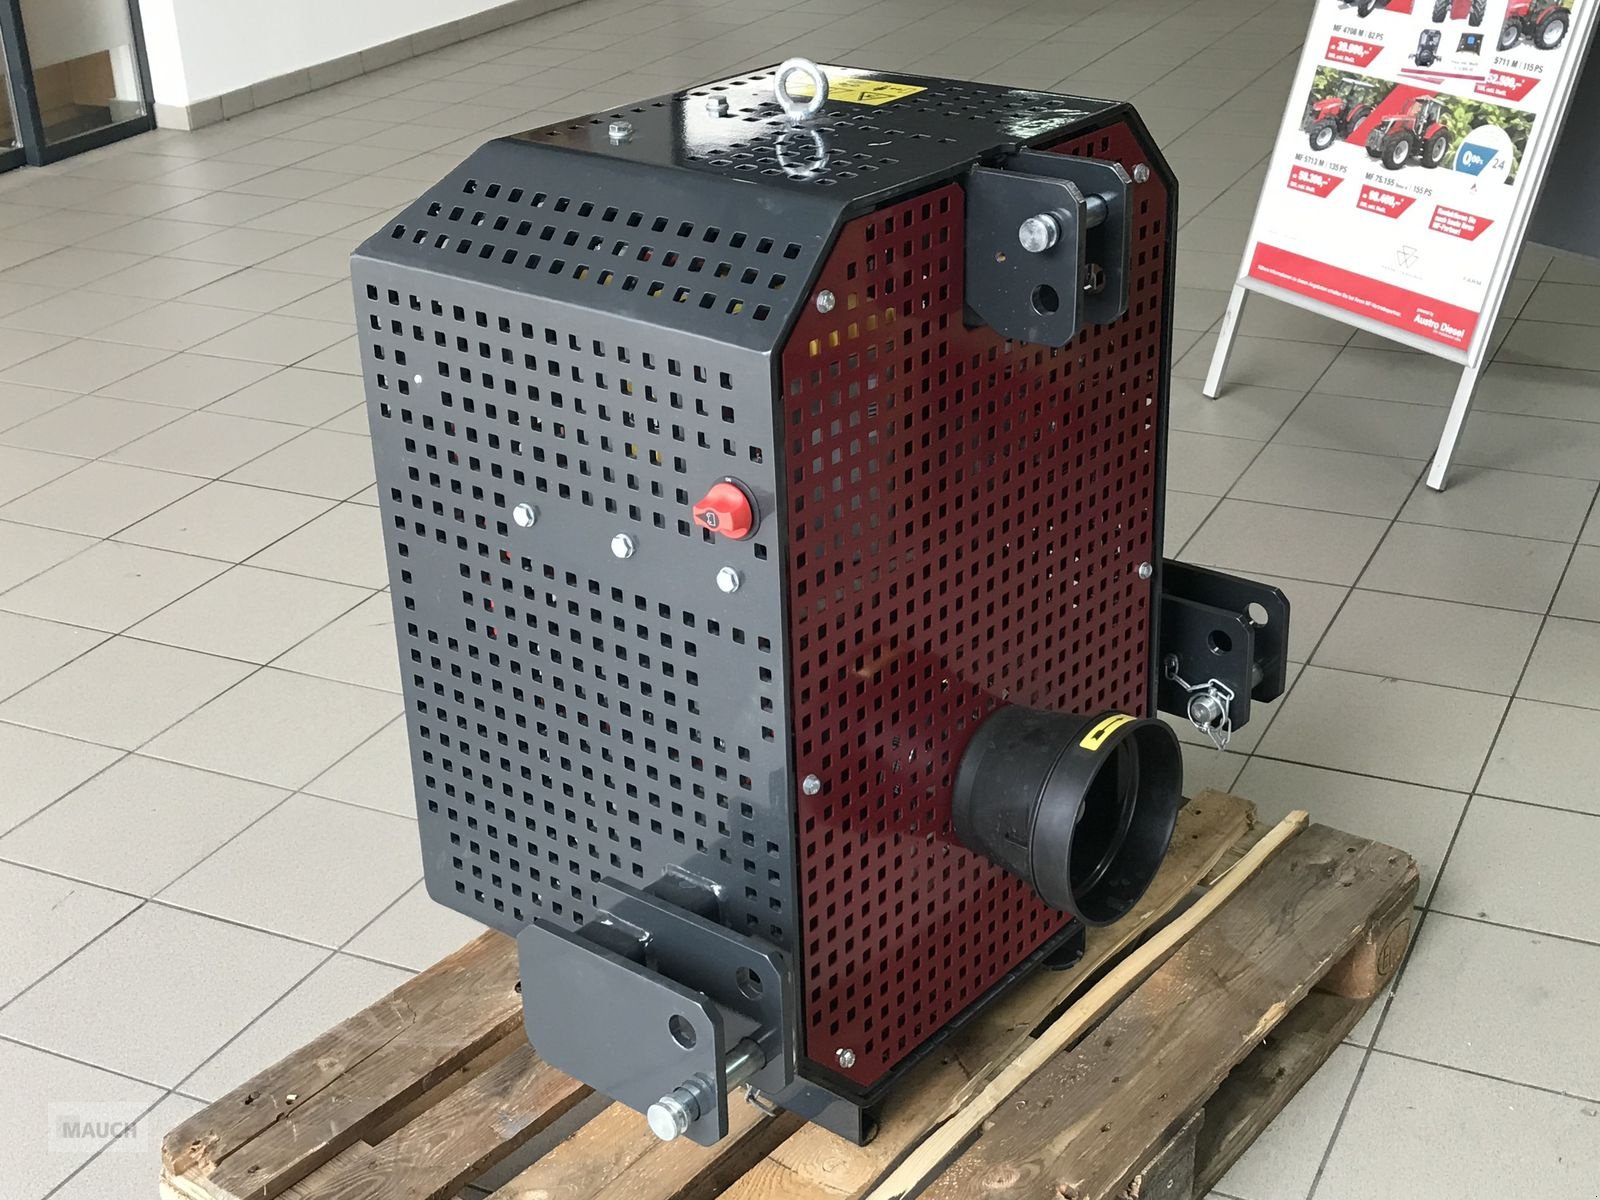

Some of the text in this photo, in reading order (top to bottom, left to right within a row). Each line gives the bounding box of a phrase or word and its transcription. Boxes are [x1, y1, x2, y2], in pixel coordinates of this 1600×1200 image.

[1534, 65, 1544, 74] PS
[1339, 165, 1348, 174] PS
[1424, 188, 1433, 197] PS
[1413, 313, 1440, 330] Austro
[1440, 322, 1466, 338] Diesel
